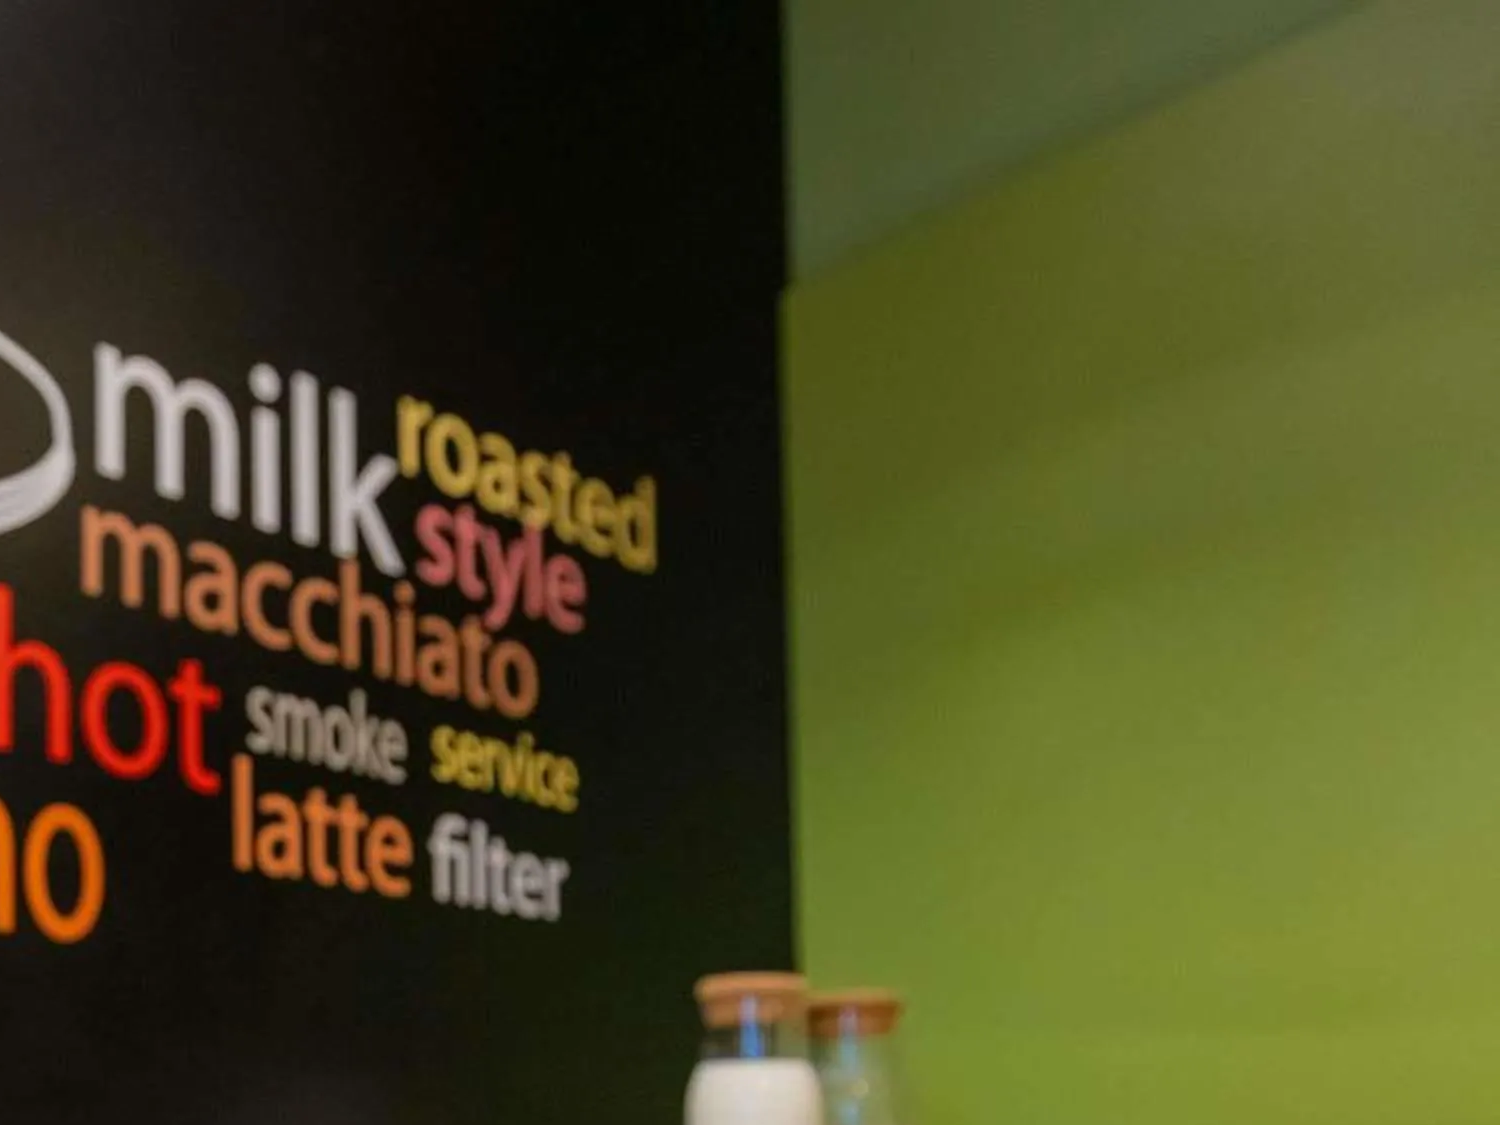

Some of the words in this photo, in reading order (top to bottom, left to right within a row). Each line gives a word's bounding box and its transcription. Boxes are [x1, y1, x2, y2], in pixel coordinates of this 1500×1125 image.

[93, 340, 405, 578] milk
[396, 395, 657, 574] roasted
[80, 504, 538, 718] macchiato
[415, 503, 588, 634] style
[245, 686, 408, 785] smoke
[430, 724, 580, 813] service
[231, 752, 414, 898] latte
[427, 812, 570, 922] filter
